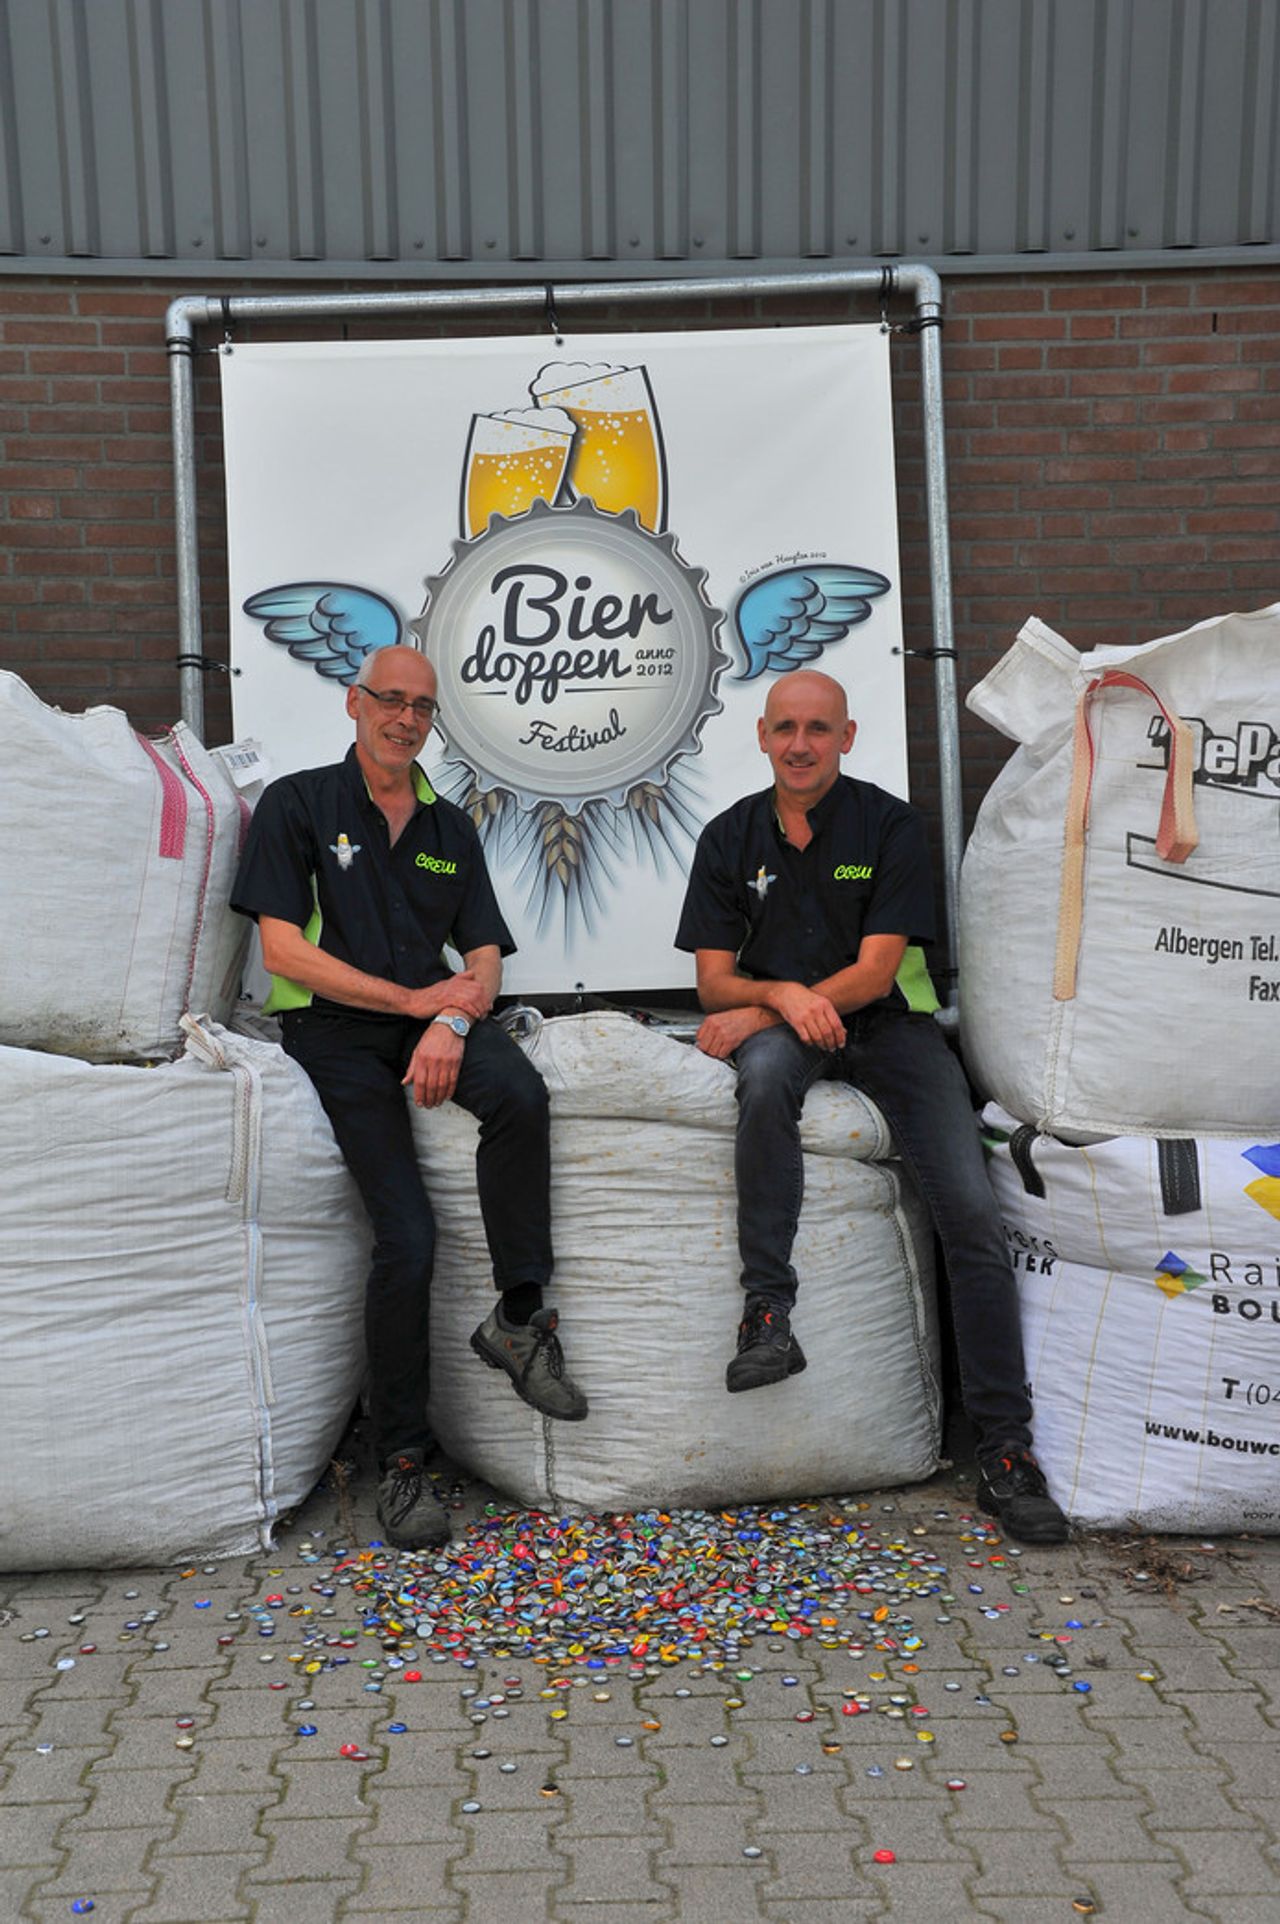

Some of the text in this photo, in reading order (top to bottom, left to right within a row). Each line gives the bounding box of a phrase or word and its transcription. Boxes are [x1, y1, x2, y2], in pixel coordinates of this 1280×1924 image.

[491, 564, 673, 646] Bier
[461, 625, 632, 705] doppen
[635, 648, 677, 660] anno
[636, 664, 673, 676] 2012
[518, 708, 627, 752] Festival
[415, 852, 457, 875] CREW
[1154, 926, 1279, 964] Albergen Tel.
[1249, 975, 1280, 1001] Fax
[1210, 1253, 1280, 1287] Rai
[1145, 1421, 1280, 1456] www.bouwc
